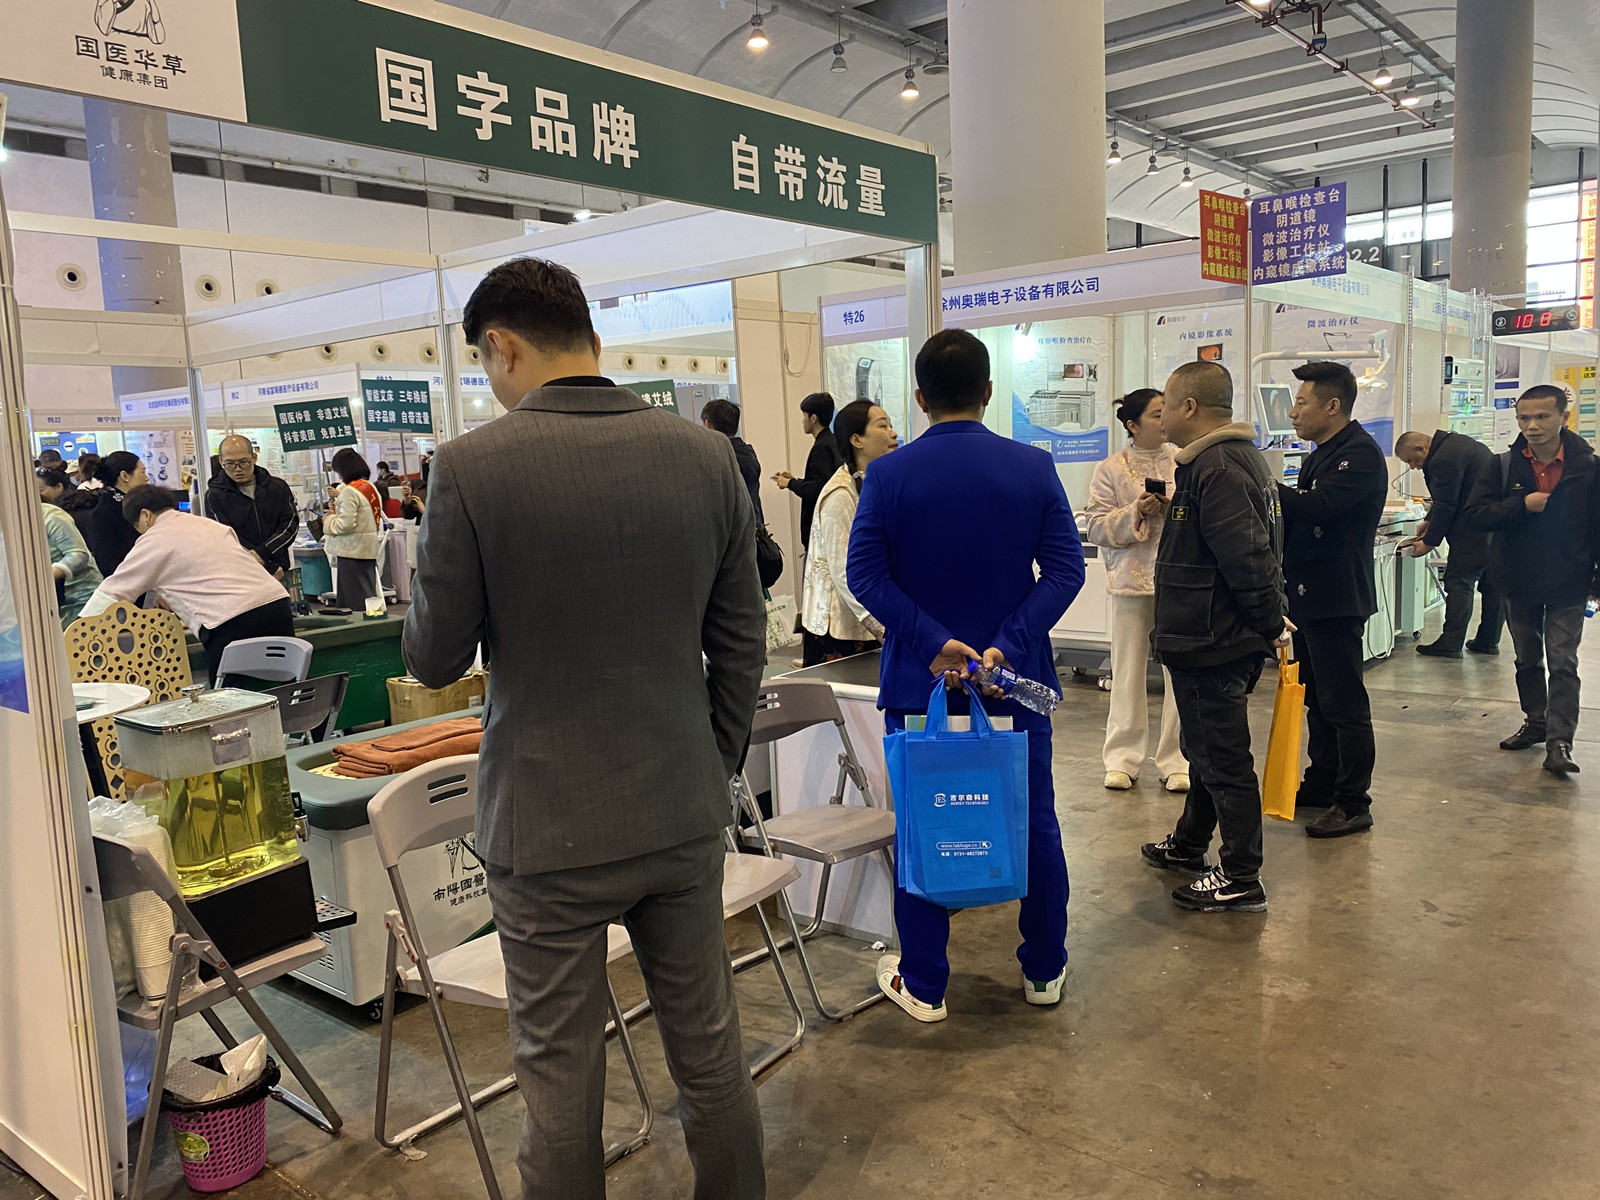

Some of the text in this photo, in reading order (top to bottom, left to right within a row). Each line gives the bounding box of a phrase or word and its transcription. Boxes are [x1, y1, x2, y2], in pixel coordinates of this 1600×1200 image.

[75, 34, 187, 76] 国医华草
[100, 64, 169, 90] 健康集团
[375, 47, 887, 218] 国字品牌 自带流量
[1203, 195, 1246, 217] 耳鼻喉检查台
[1258, 187, 1341, 215] 耳鼻喉检查台
[1213, 213, 1235, 230] 阴道镜
[1276, 208, 1317, 228] 阴道镜
[1206, 228, 1242, 247] 微波治疗仪
[1262, 223, 1330, 247] 微波治疗仪
[1207, 245, 1242, 264] 影像工作站
[1262, 240, 1331, 263] 影像工作站
[1346, 246, 1380, 263] 2.2
[1202, 261, 1248, 281] 内窥镜成像系统
[1253, 255, 1345, 281] 内窥镜成像系统
[843, 309, 865, 326] 特26
[1307, 316, 1359, 329] 微波治疗仪
[1179, 328, 1233, 341] 内镜影像系统
[365, 389, 428, 404] 智能艾床 三年换新
[367, 409, 430, 425] 国字品牌 自带流量
[283, 425, 353, 444] 抖音美团 免费上架
